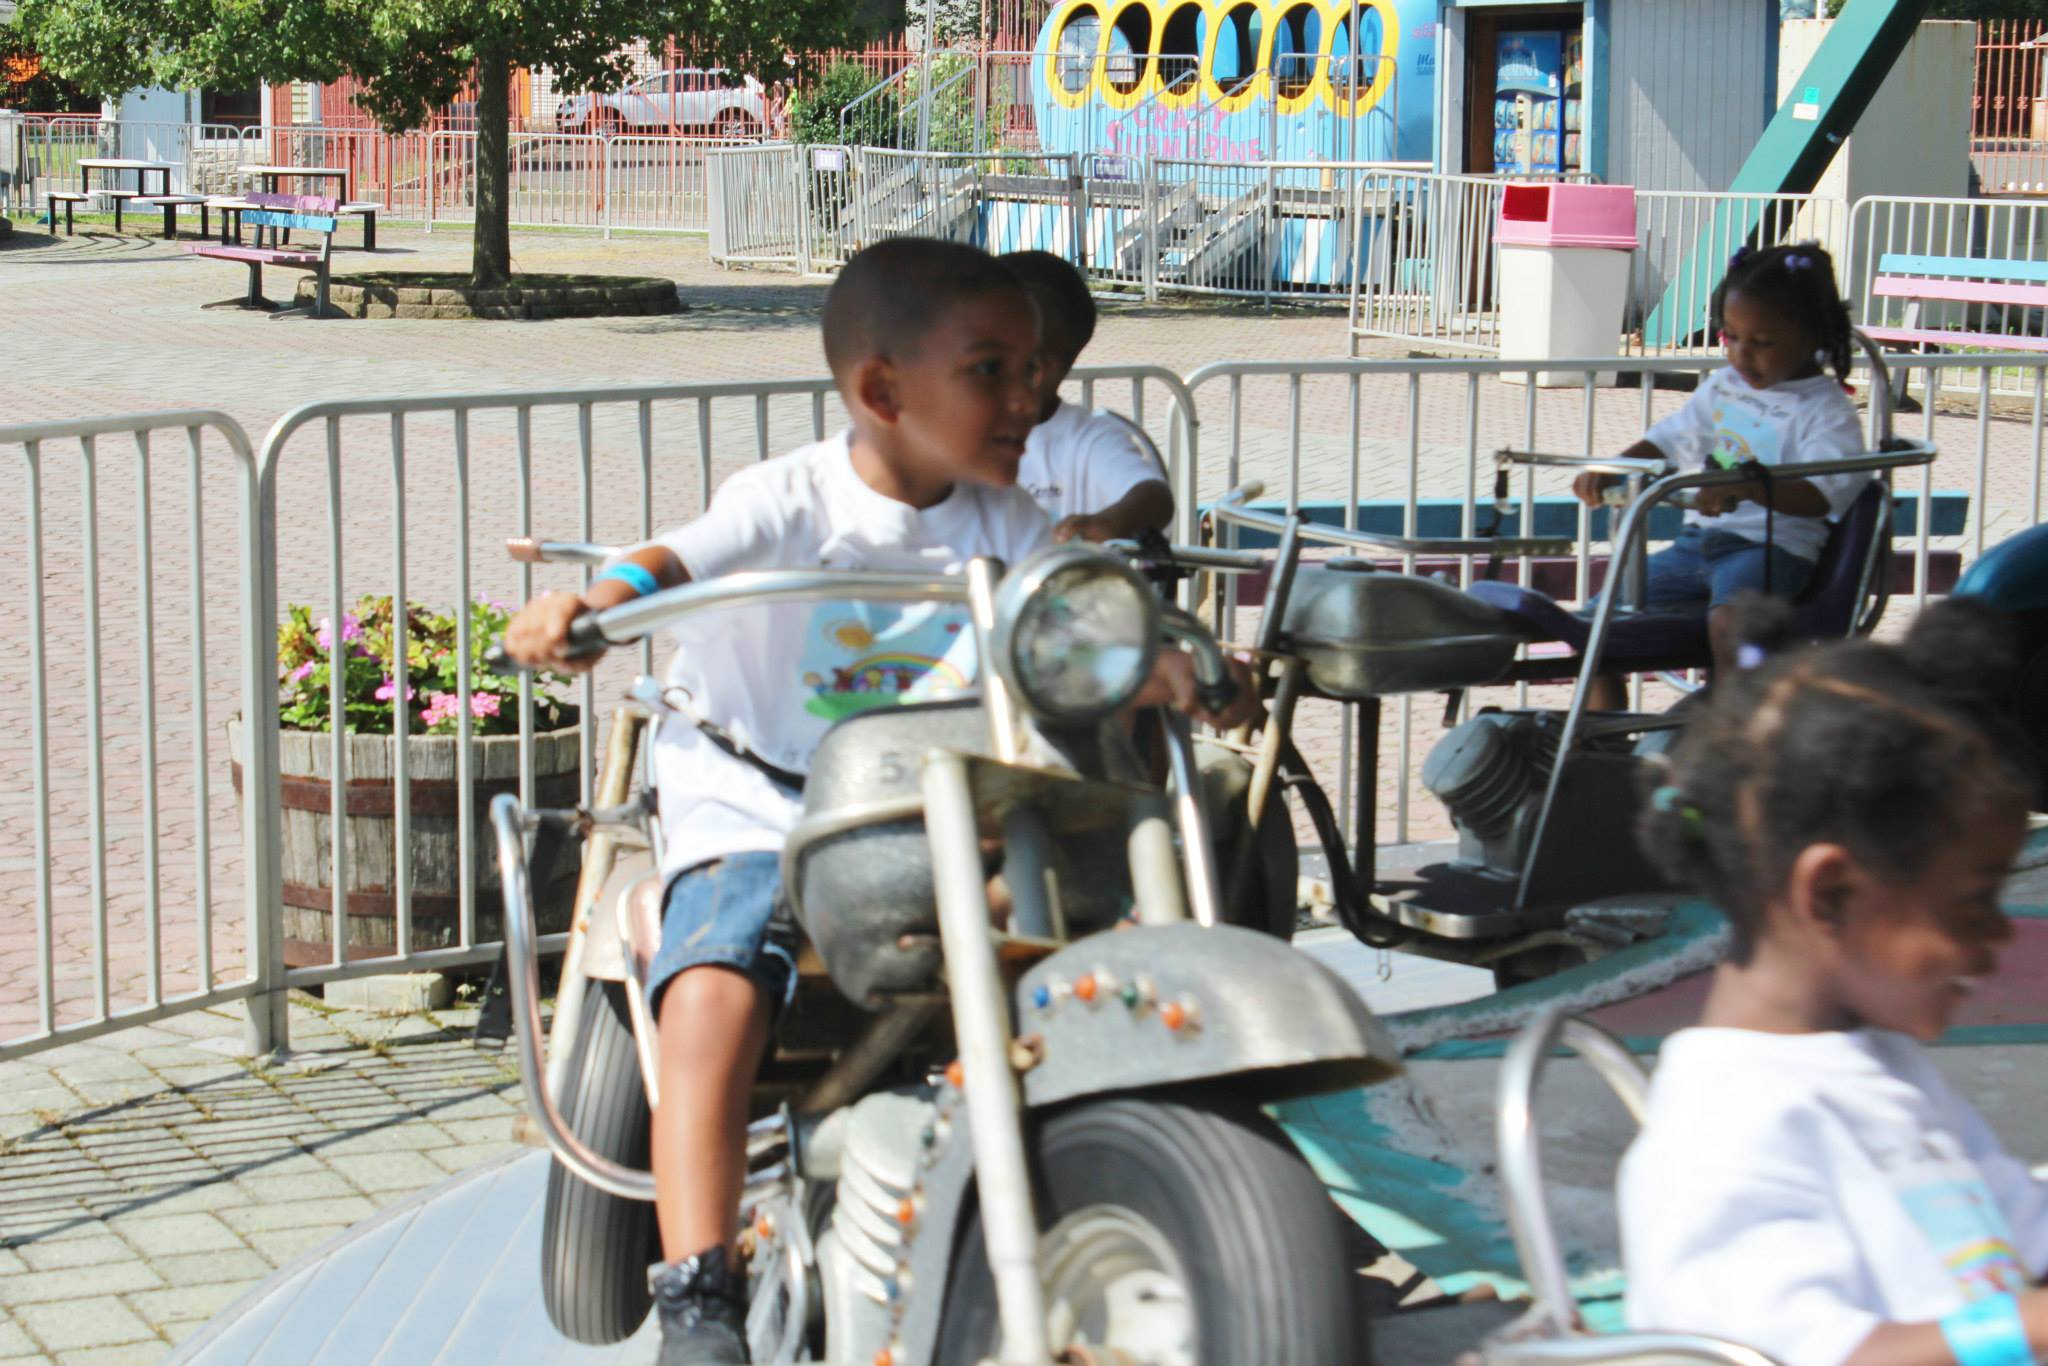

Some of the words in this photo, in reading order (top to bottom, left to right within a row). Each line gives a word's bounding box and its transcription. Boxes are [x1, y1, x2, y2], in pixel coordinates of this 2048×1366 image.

[1133, 102, 1229, 132] CRAZY
[1104, 120, 1262, 161] SUBMARINE
[880, 751, 905, 785] 5
